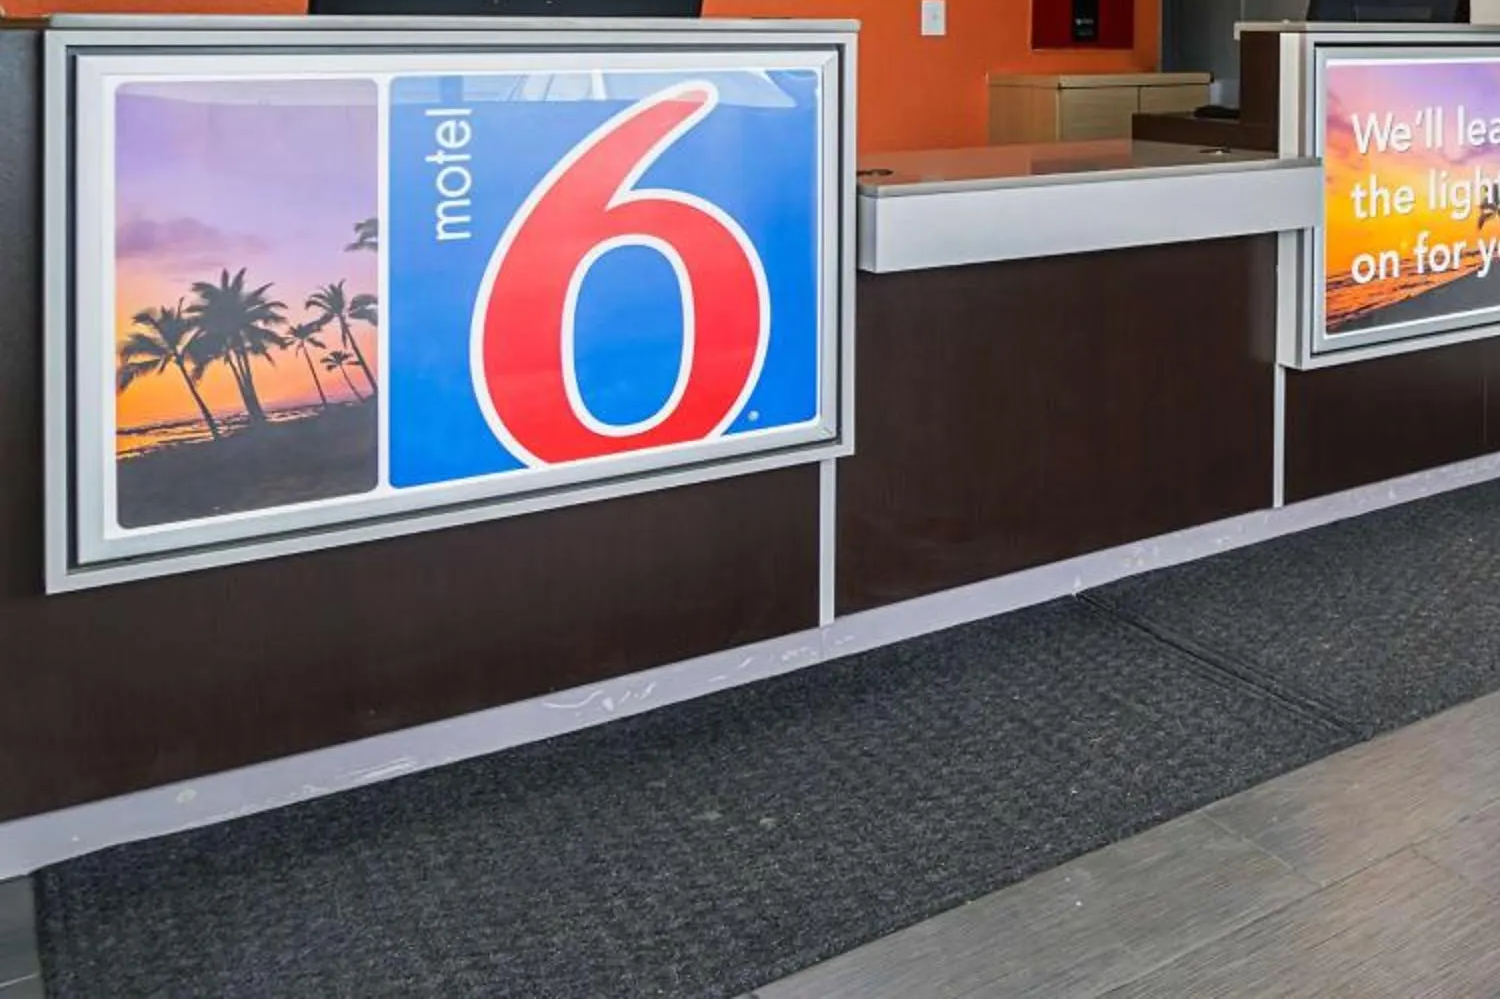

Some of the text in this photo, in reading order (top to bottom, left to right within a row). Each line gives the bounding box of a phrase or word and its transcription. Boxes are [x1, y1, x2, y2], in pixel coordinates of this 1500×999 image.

[1351, 106, 1443, 153] We'll
[1350, 173, 1417, 220] the
[425, 79, 771, 470] motel 6
[1351, 249, 1401, 284] on
[1412, 229, 1468, 275] for
